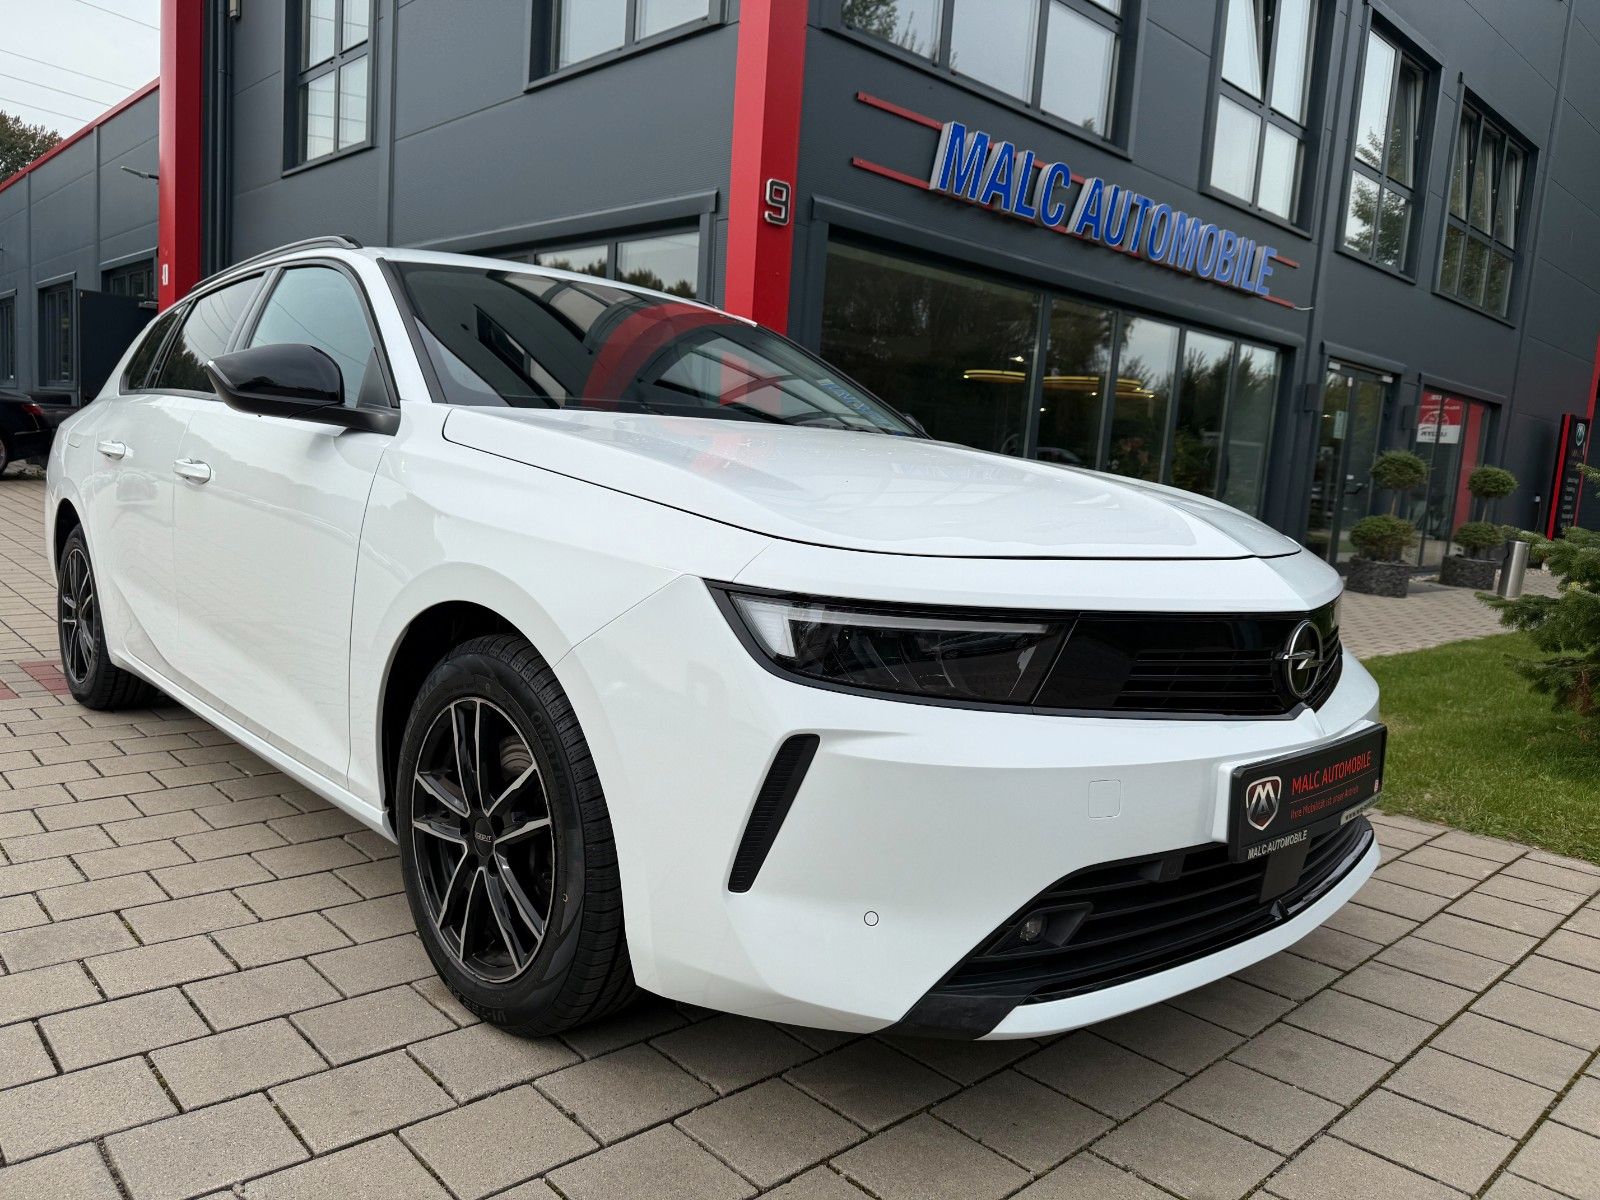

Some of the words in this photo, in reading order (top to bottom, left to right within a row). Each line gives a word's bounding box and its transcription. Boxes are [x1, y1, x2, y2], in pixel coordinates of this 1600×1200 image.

[764, 178, 791, 226] 9
[930, 121, 1071, 227] MALC
[1067, 177, 1278, 296] AUTOMOBILE
[1291, 769, 1320, 796] MALC
[1321, 750, 1372, 784] AUTOMOBILE
[1247, 844, 1267, 860] MALC
[1267, 829, 1308, 852] AUTOMOBILE
